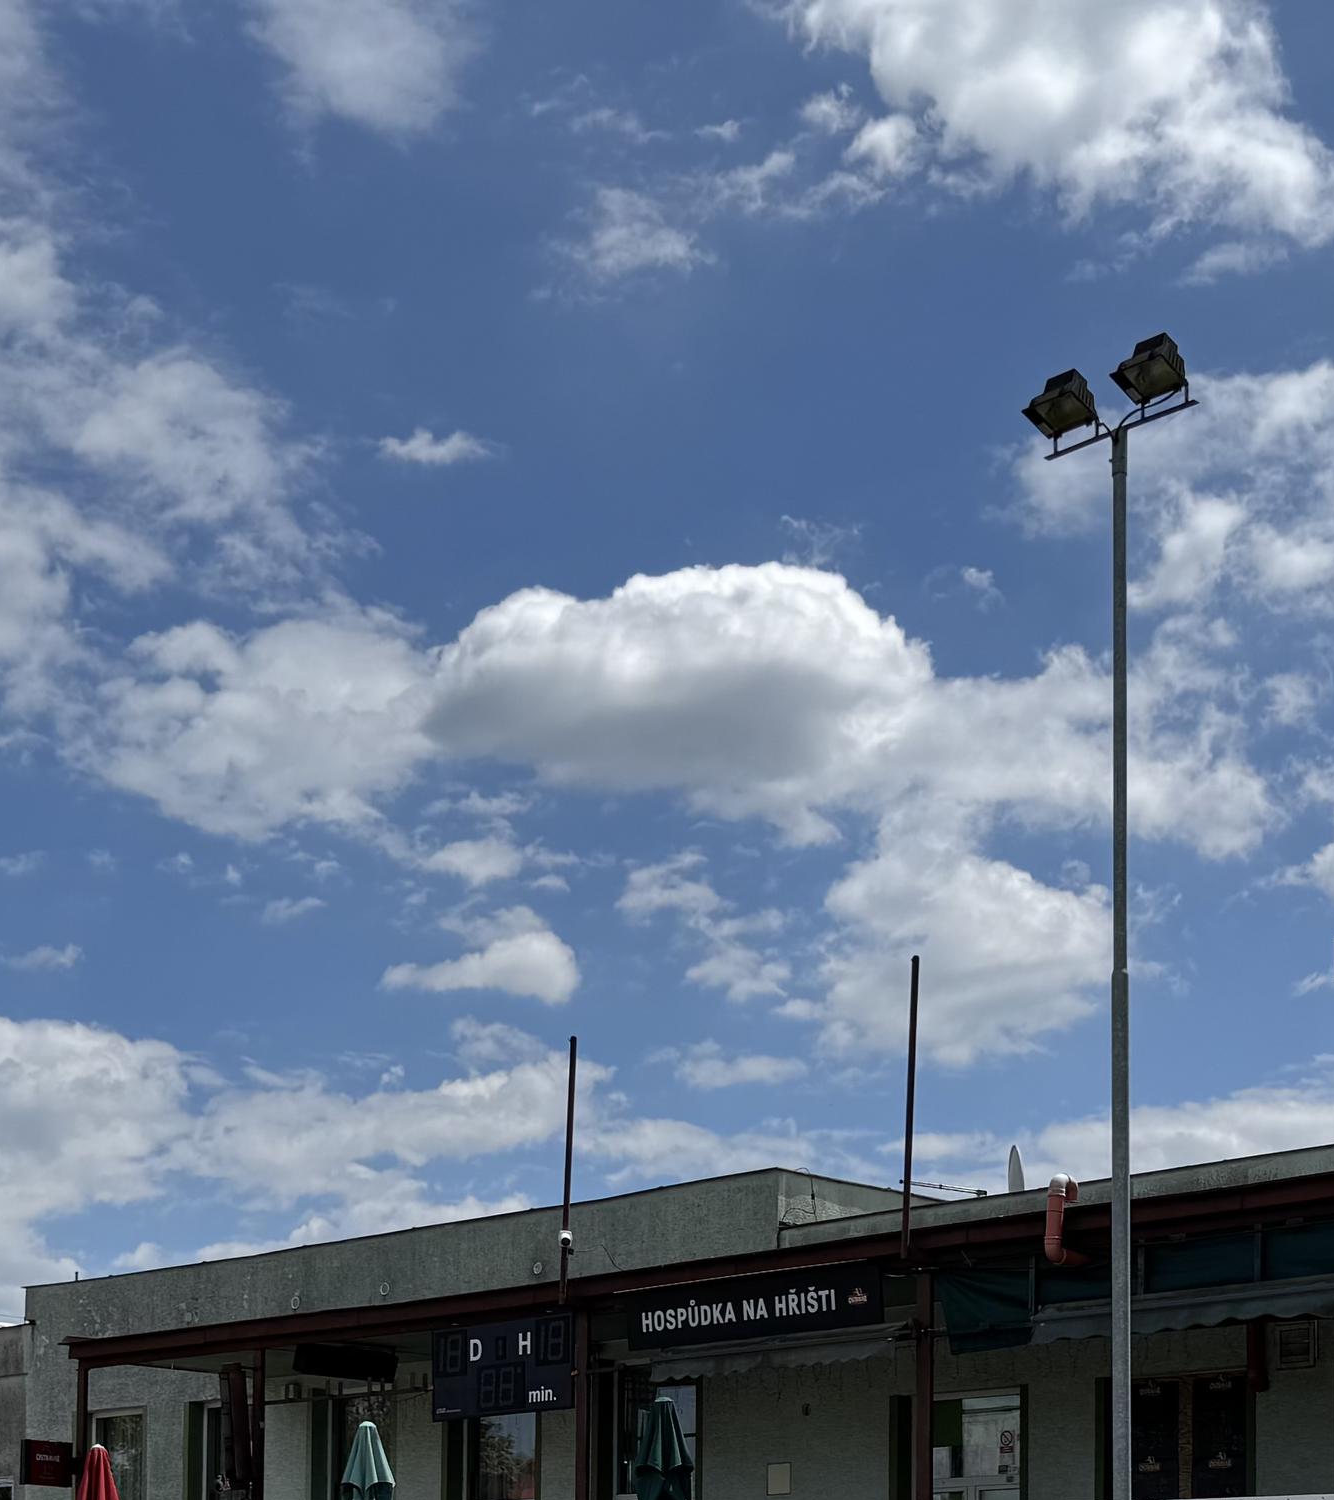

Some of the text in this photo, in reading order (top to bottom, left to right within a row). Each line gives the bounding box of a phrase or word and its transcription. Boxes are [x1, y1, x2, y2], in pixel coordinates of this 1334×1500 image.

[642, 1286, 836, 1333] HOSPŮDKA NA HŘIŠTI
[469, 1331, 532, 1362] D H
[528, 1386, 557, 1403] min.
